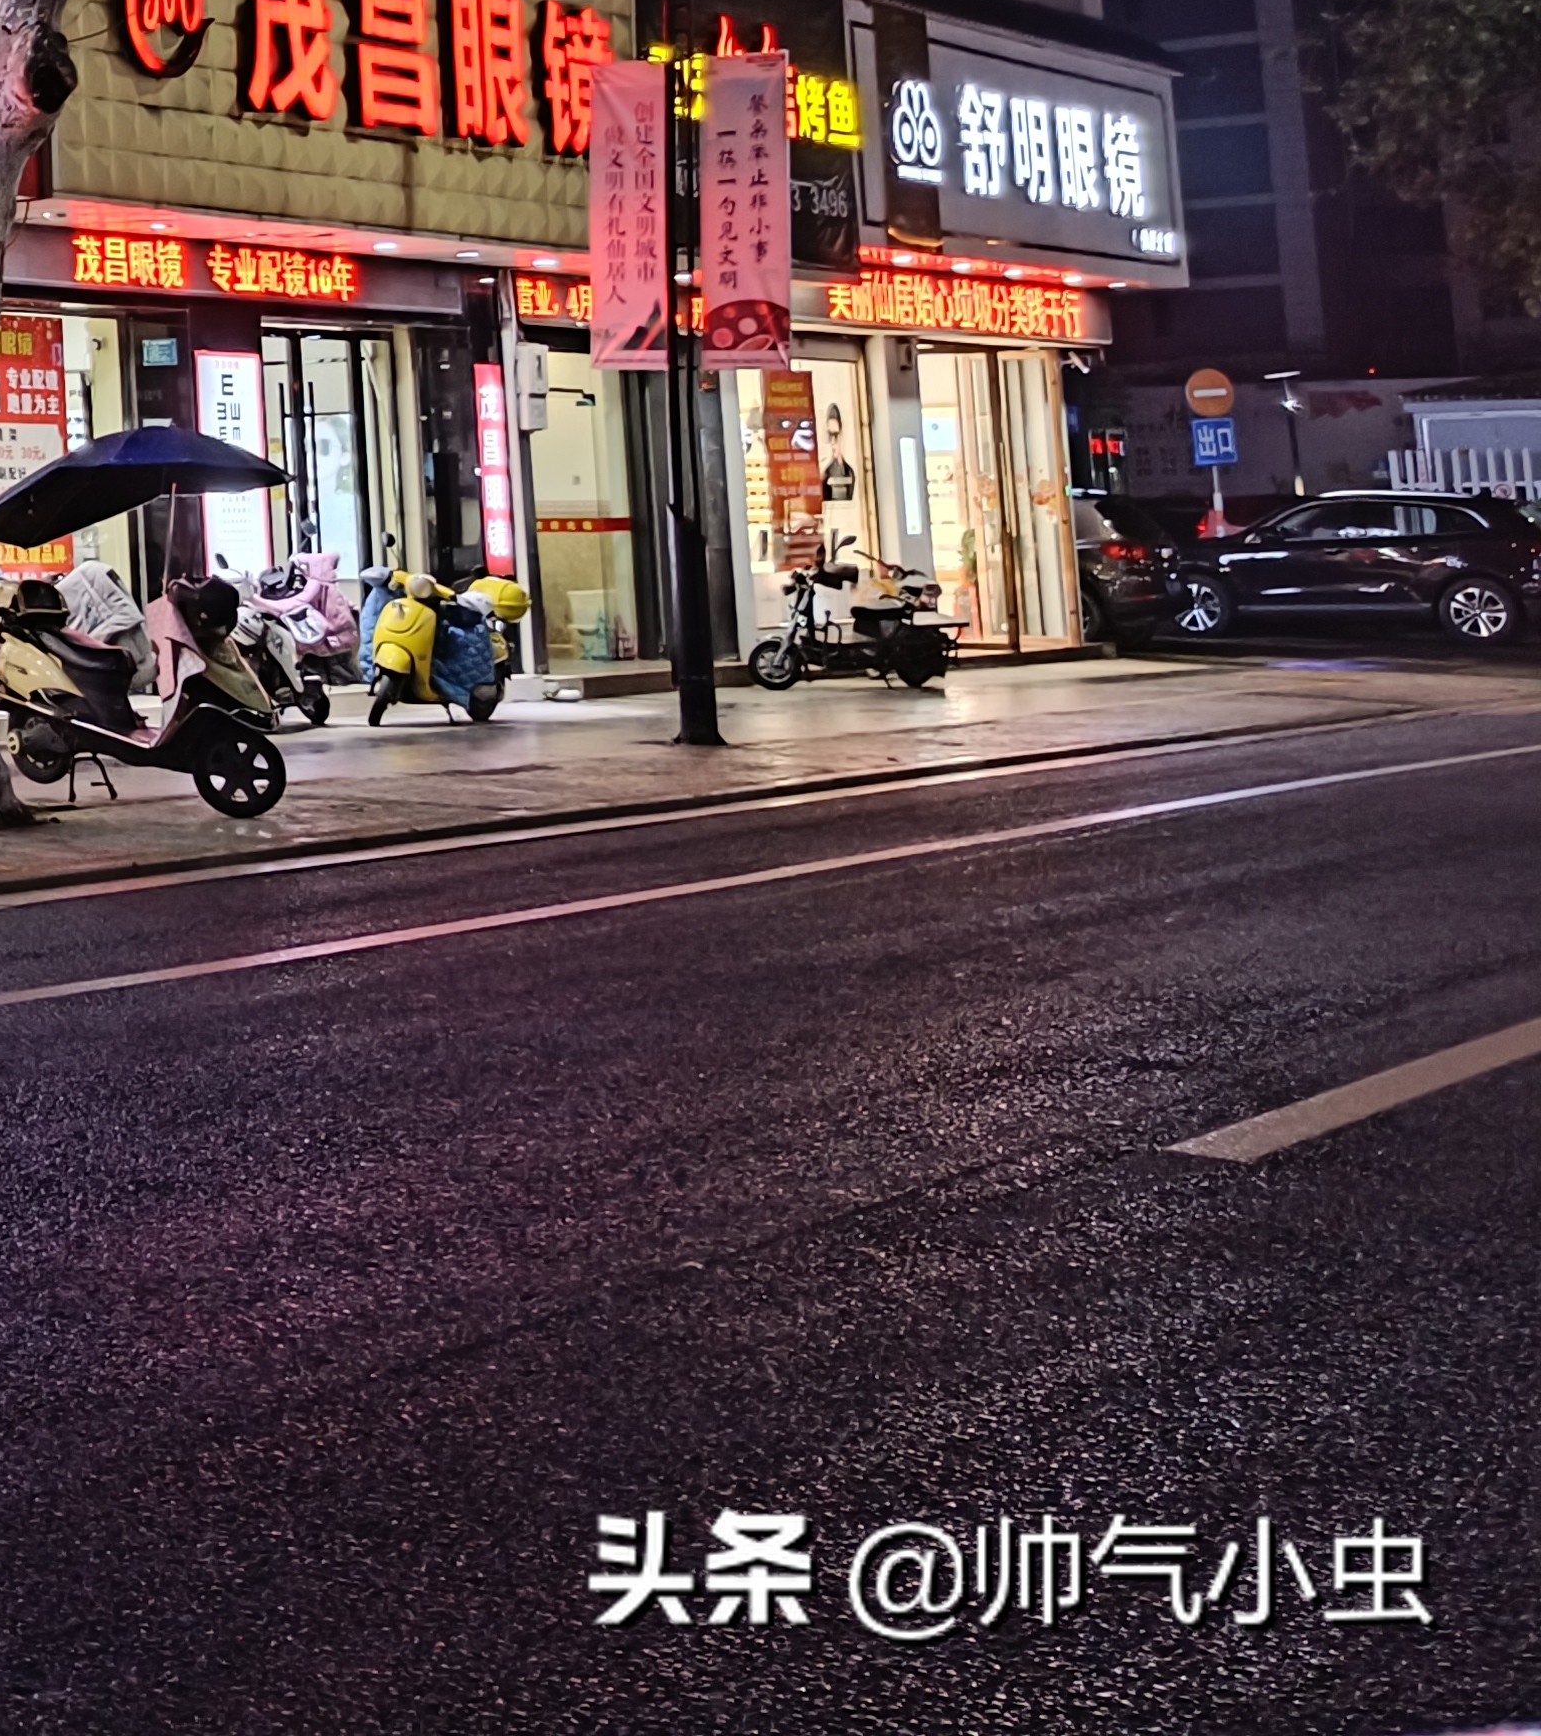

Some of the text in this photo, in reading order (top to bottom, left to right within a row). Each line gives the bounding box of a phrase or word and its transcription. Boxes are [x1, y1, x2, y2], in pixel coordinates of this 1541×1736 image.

[633, 100, 658, 284] 创建全国文明城市
[958, 82, 1147, 219] 舒明眼镜
[71, 235, 356, 302] 茂昌眼镜 专业配镜16年
[1196, 420, 1238, 460] 出口
